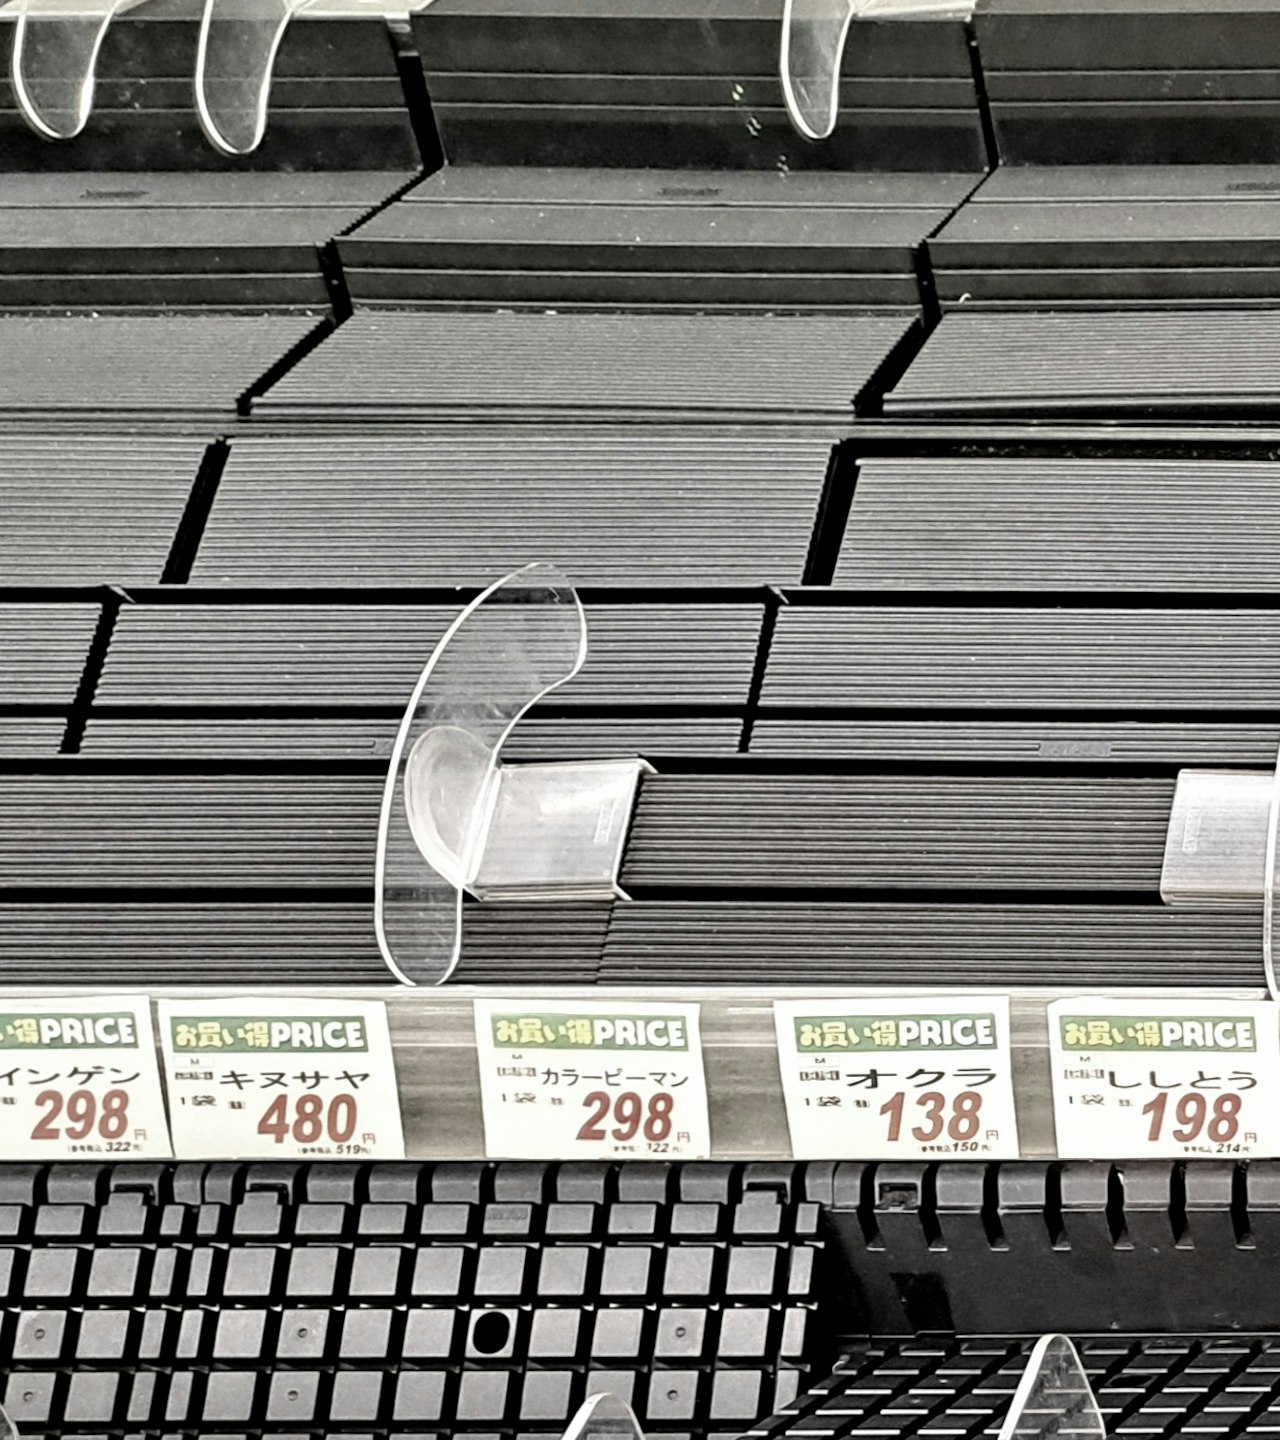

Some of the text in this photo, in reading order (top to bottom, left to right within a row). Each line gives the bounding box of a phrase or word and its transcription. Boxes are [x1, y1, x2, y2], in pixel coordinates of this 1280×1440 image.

[0, 1066, 140, 1085] インゲン
[219, 1070, 370, 1090] キヌサヤ
[846, 1068, 997, 1089] オクラ
[1109, 1071, 1258, 1090] ししとう
[30, 1089, 129, 1140] 298
[257, 1093, 357, 1144] 480
[575, 1091, 674, 1142] 298
[880, 1091, 983, 1142] 138
[1142, 1092, 1242, 1142] 198
